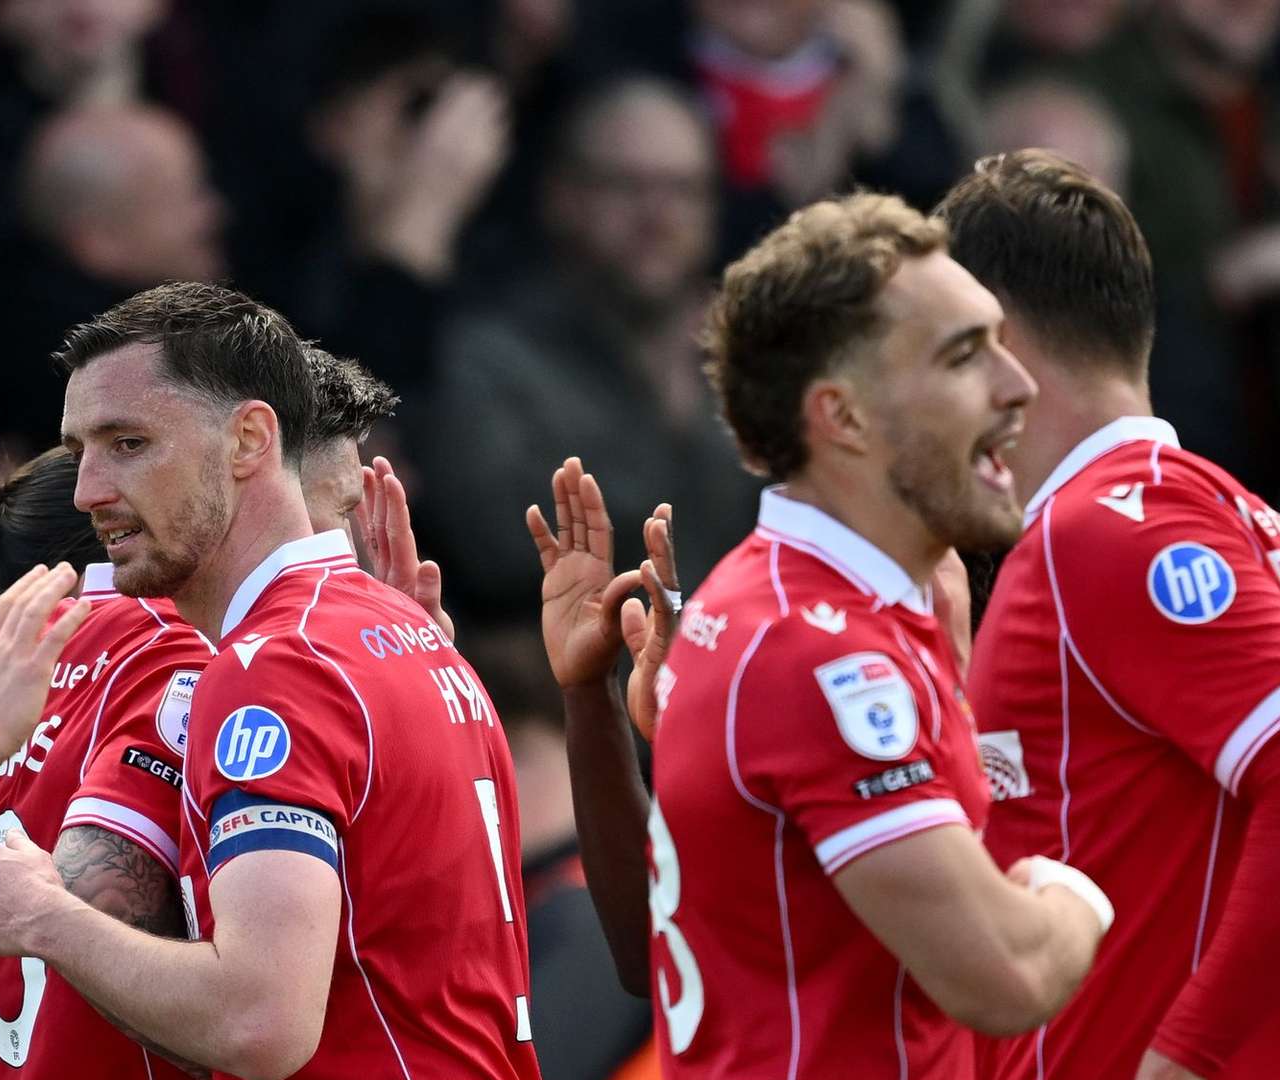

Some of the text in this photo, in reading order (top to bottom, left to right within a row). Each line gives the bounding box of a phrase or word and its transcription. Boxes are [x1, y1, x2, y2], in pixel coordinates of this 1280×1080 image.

[1157, 549, 1224, 620] hp
[392, 620, 454, 654] Met
[177, 677, 196, 688] sk
[429, 665, 494, 727] HYA
[225, 709, 281, 778] hp
[223, 814, 254, 833] EFL
